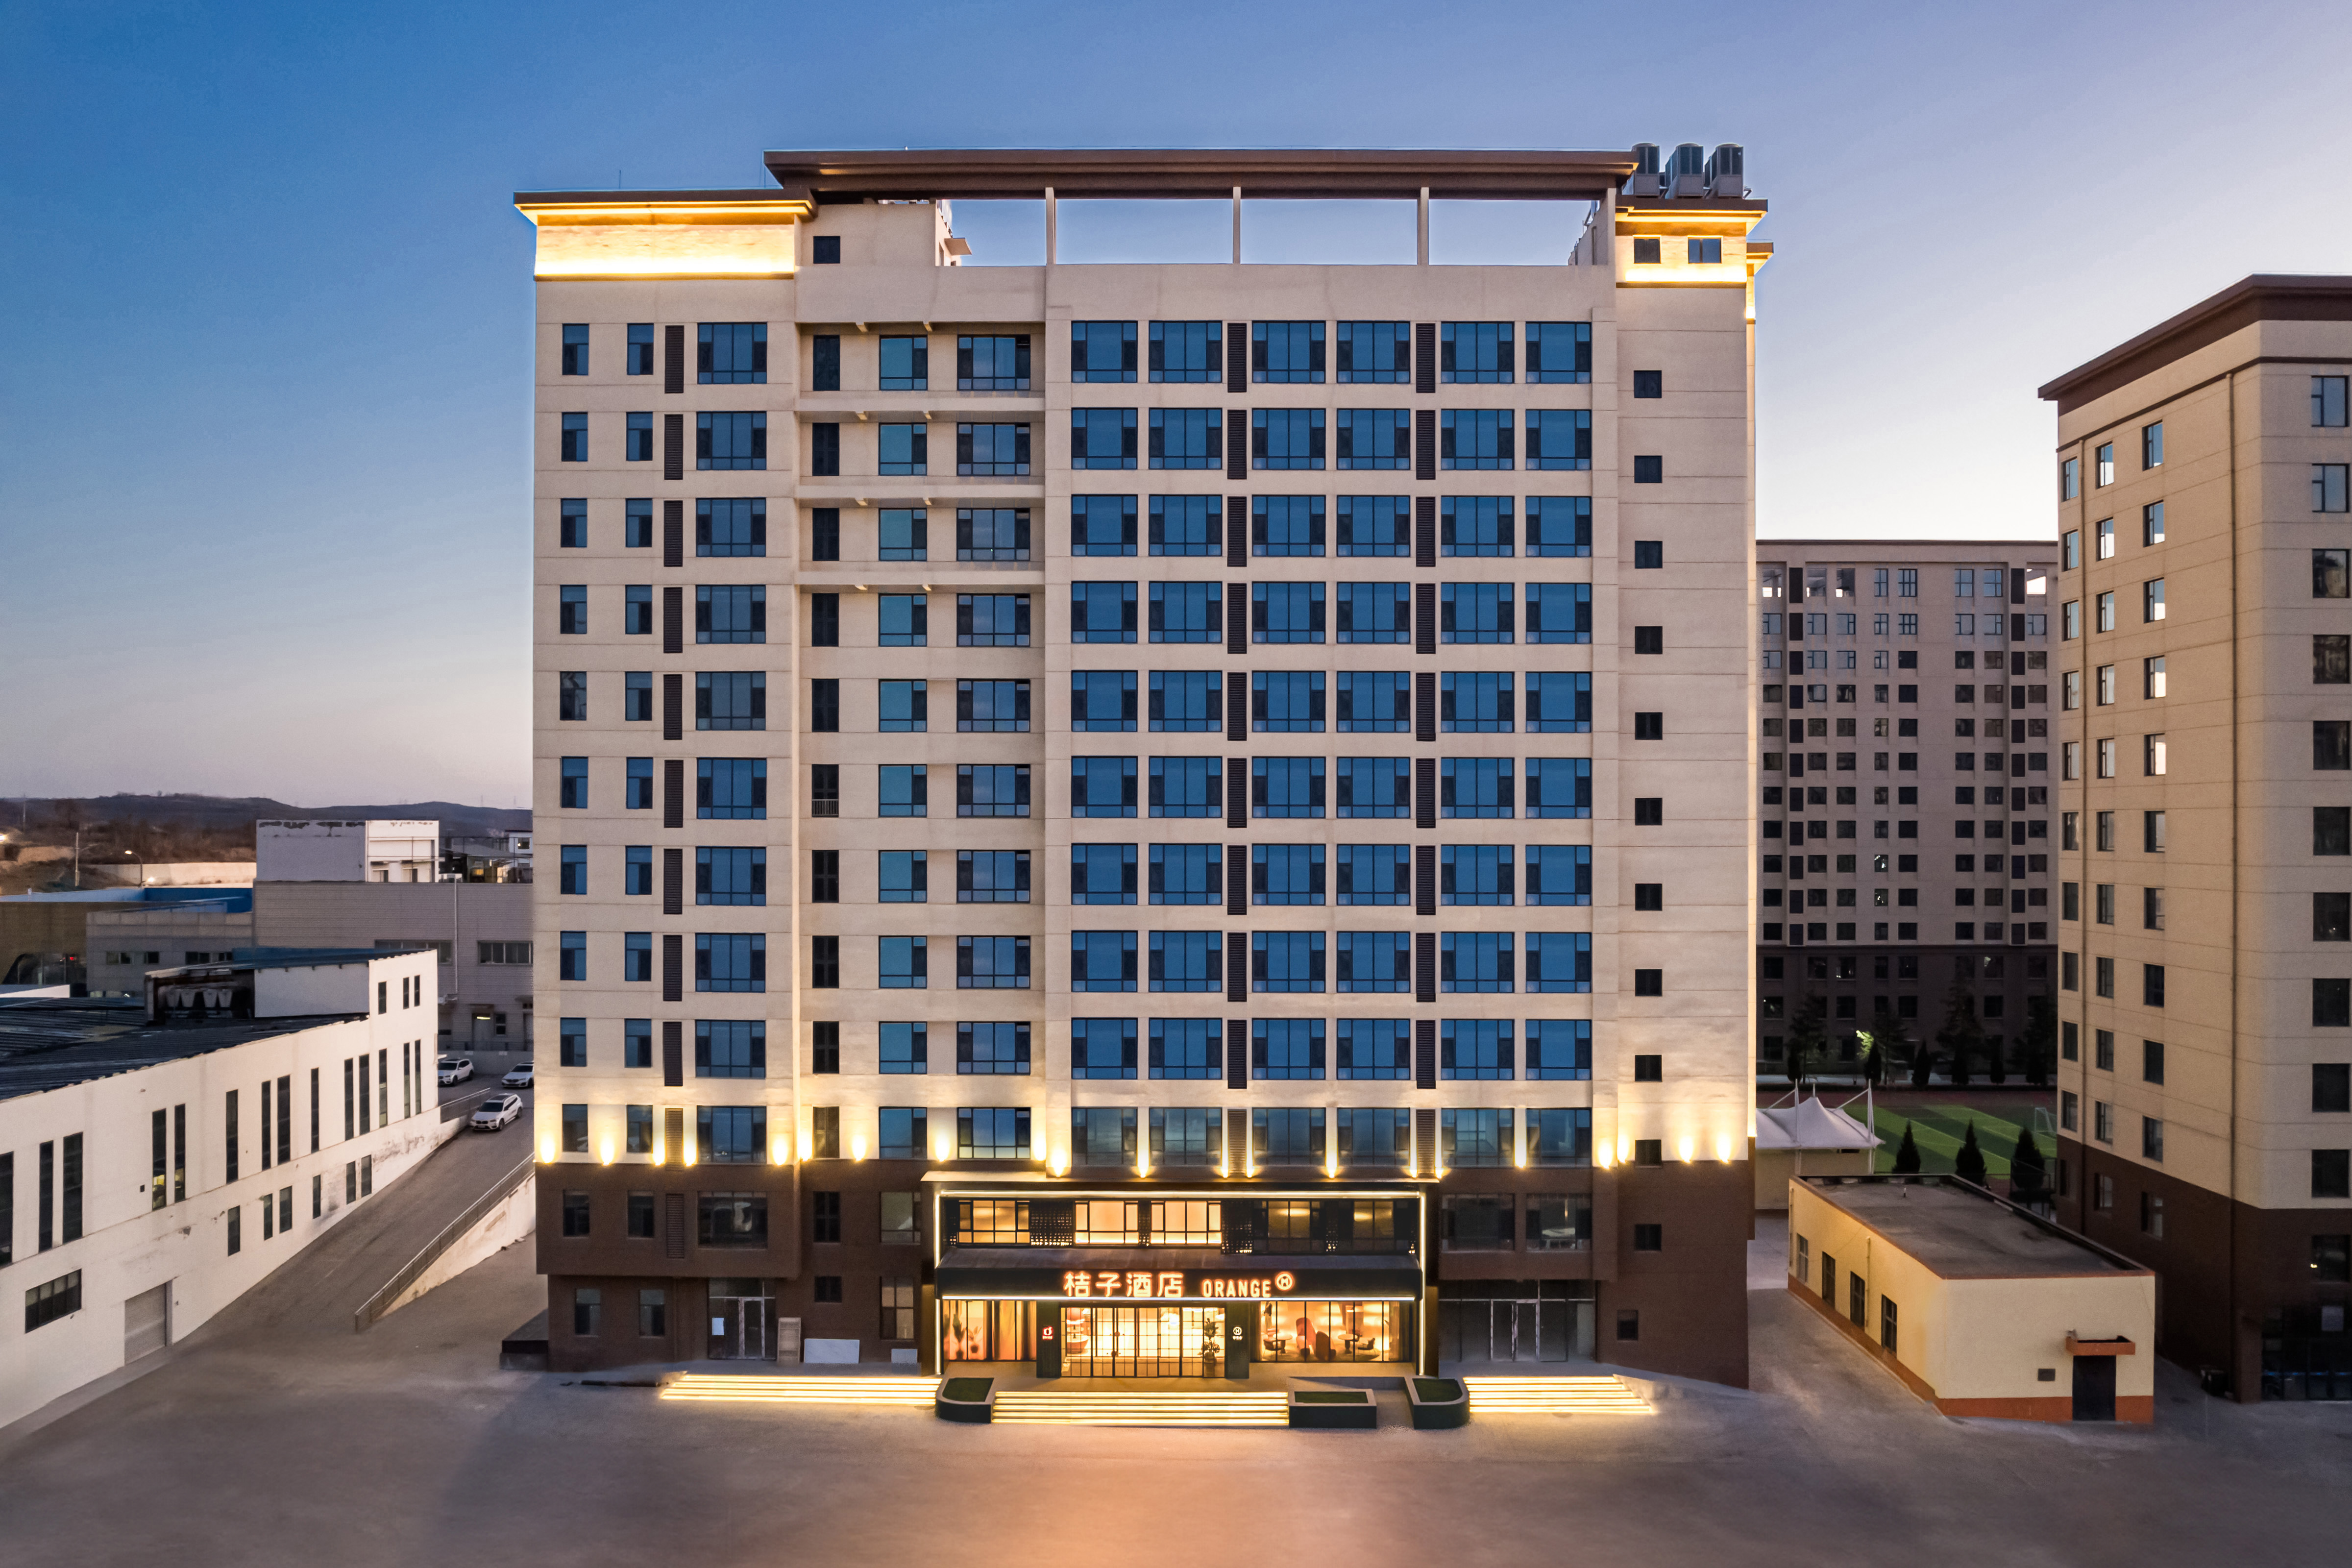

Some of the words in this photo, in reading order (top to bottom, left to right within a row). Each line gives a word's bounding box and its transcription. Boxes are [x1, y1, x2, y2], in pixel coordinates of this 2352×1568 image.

[1064, 1272, 1183, 1297] 桔子酒店
[1202, 1279, 1271, 1298] ORANGE
